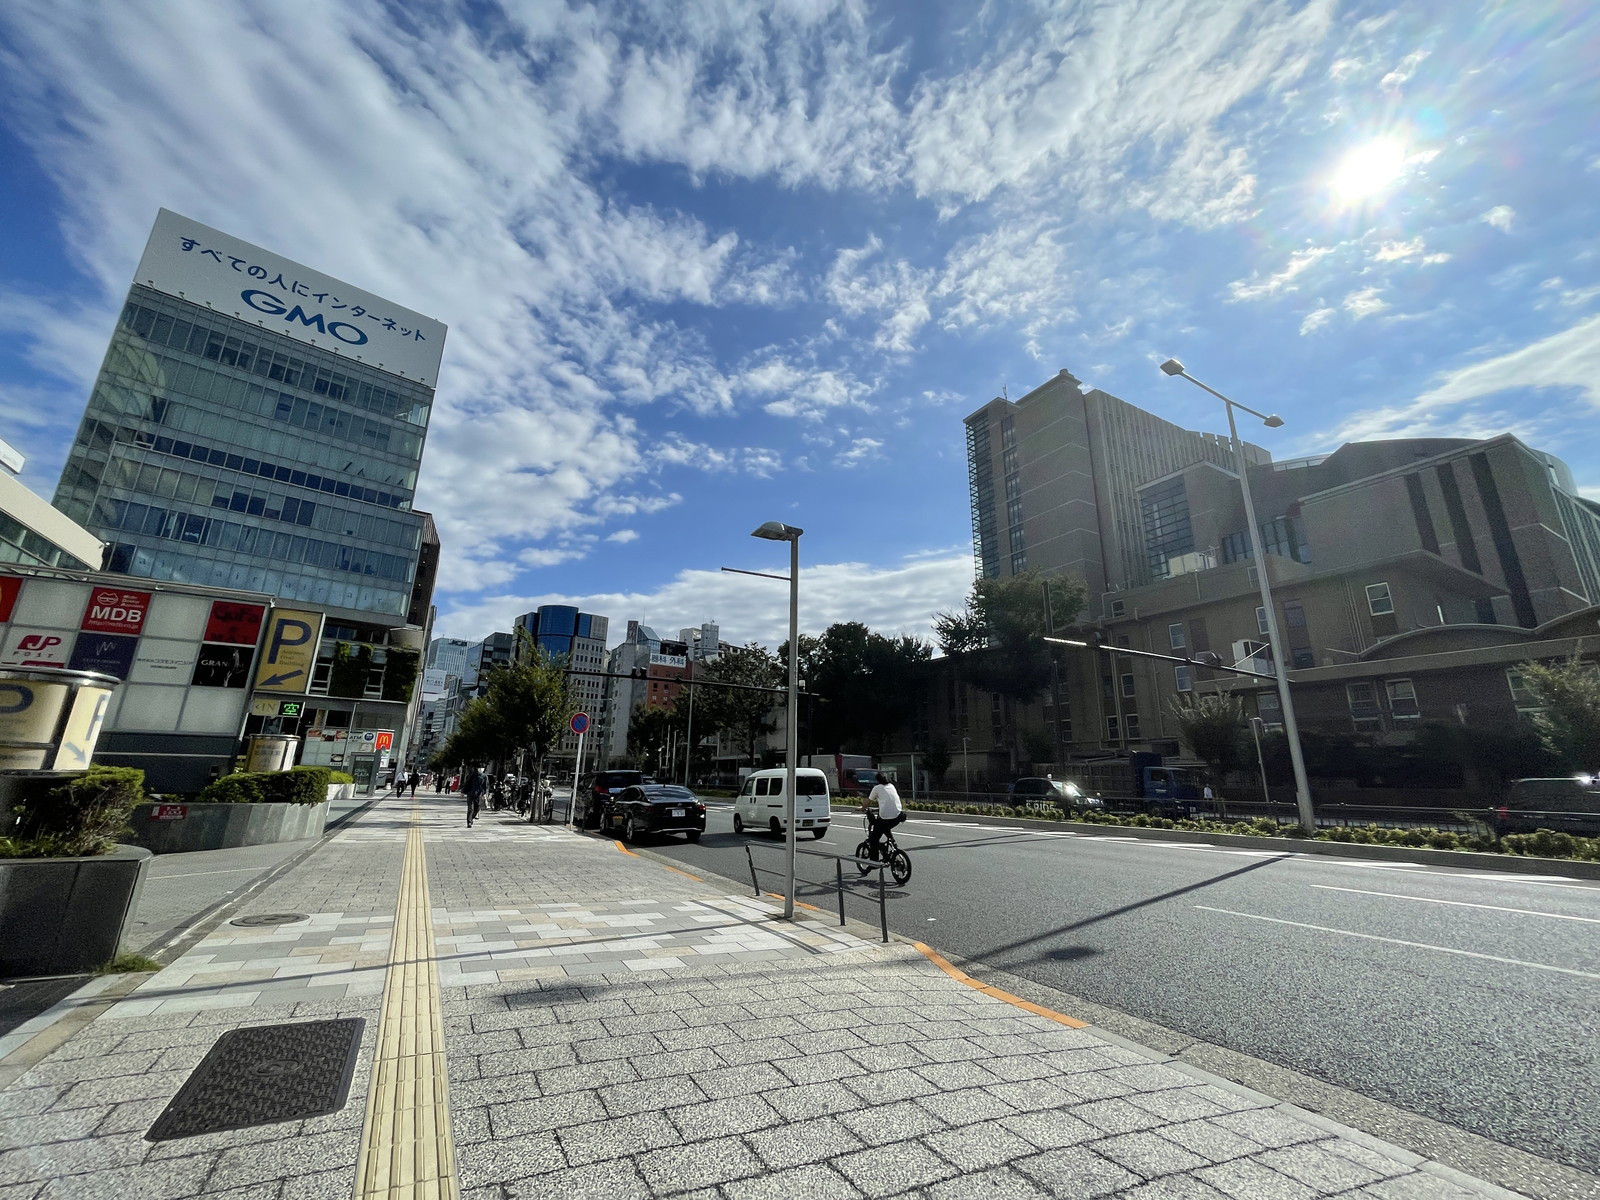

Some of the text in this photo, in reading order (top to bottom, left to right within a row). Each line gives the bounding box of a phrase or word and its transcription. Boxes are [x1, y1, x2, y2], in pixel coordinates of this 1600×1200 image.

[181, 236, 426, 342] すべての人にインターネット
[240, 289, 368, 346] GMO
[91, 605, 142, 623] MDB
[12, 651, 54, 659] POST
[267, 618, 312, 664] P
[282, 703, 300, 716] 空
